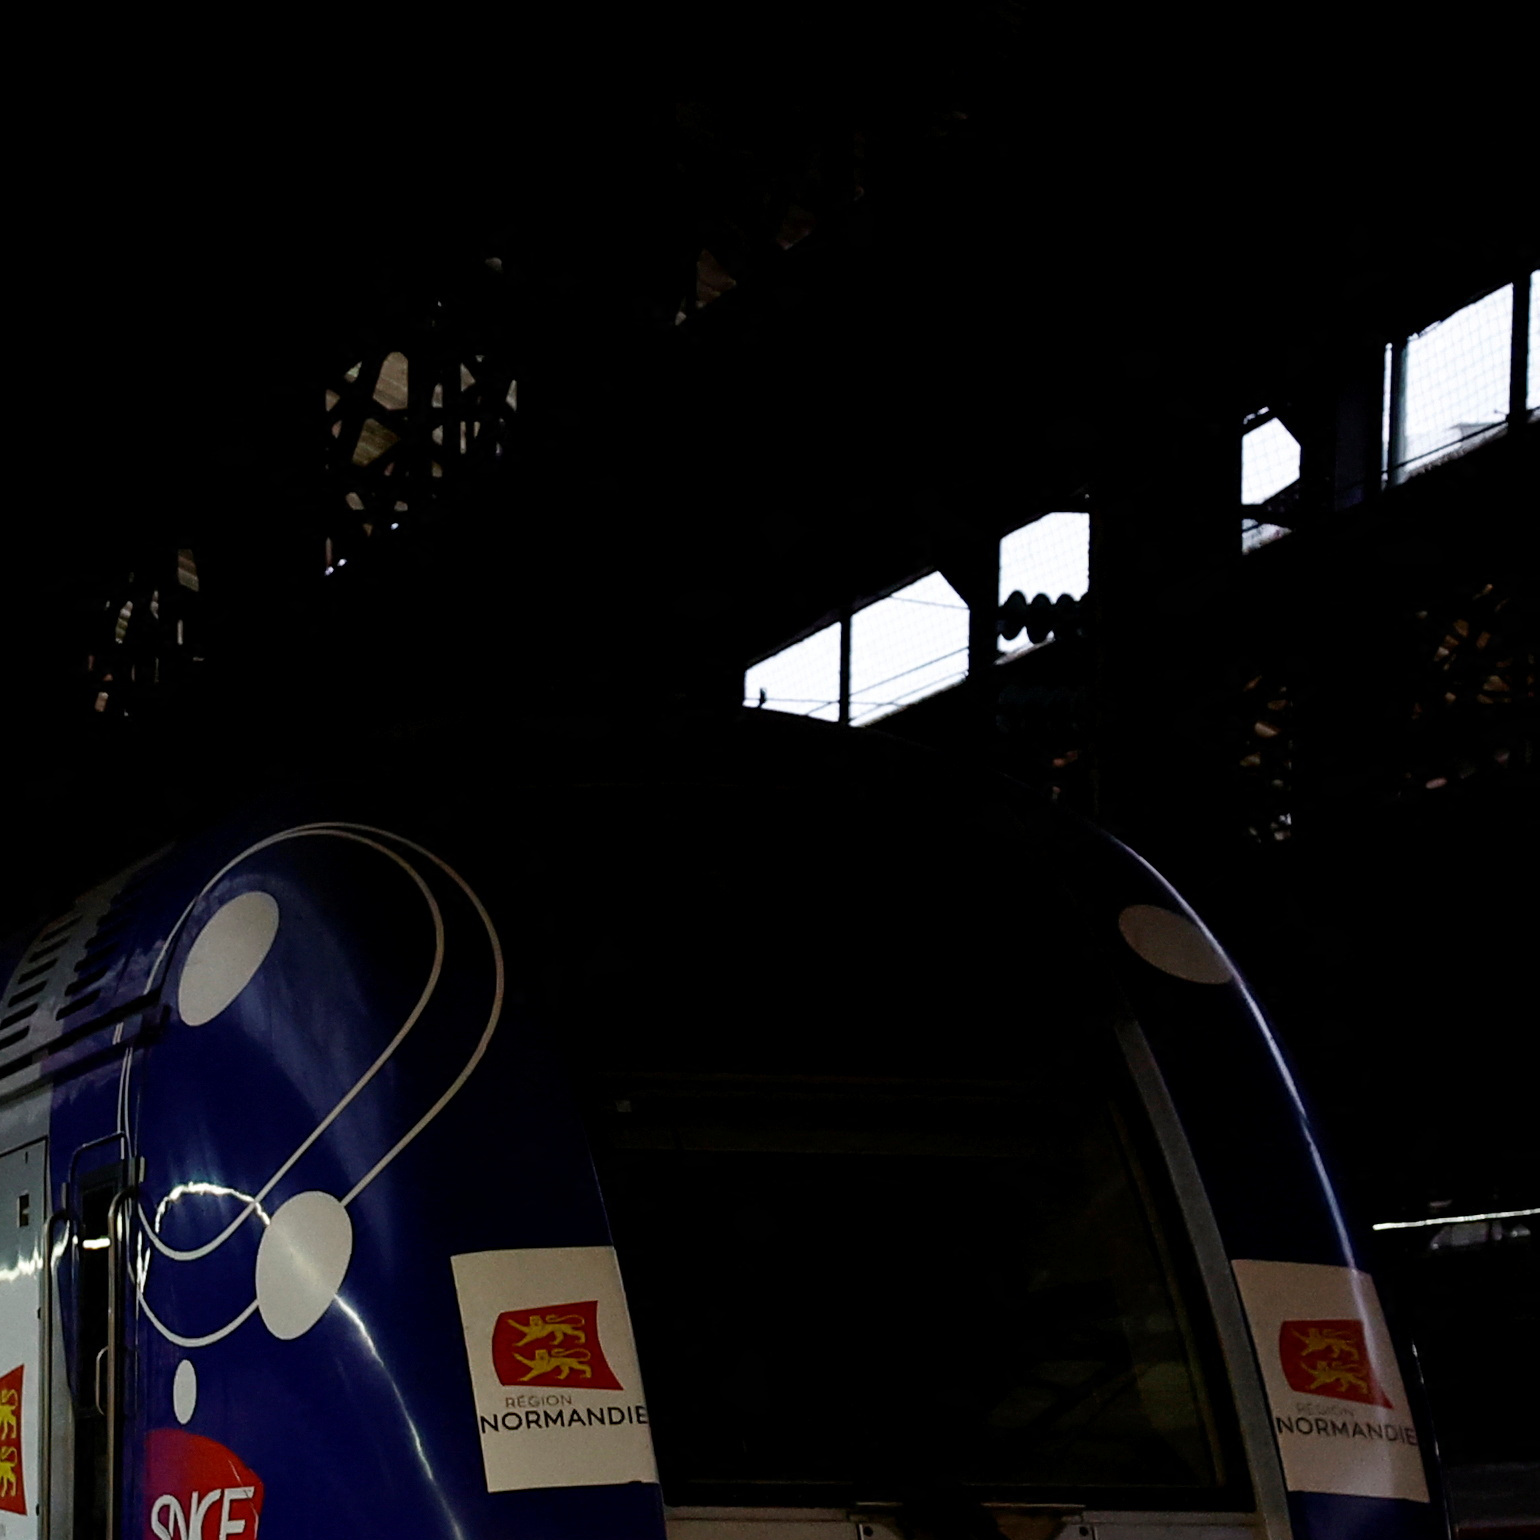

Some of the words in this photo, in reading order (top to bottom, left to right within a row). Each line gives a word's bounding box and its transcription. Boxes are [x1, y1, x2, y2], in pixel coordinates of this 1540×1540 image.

[505, 1394, 572, 1409] RÉGION
[480, 1405, 649, 1434] NORMANDIE
[1275, 1416, 1419, 1446] NORMANDIE
